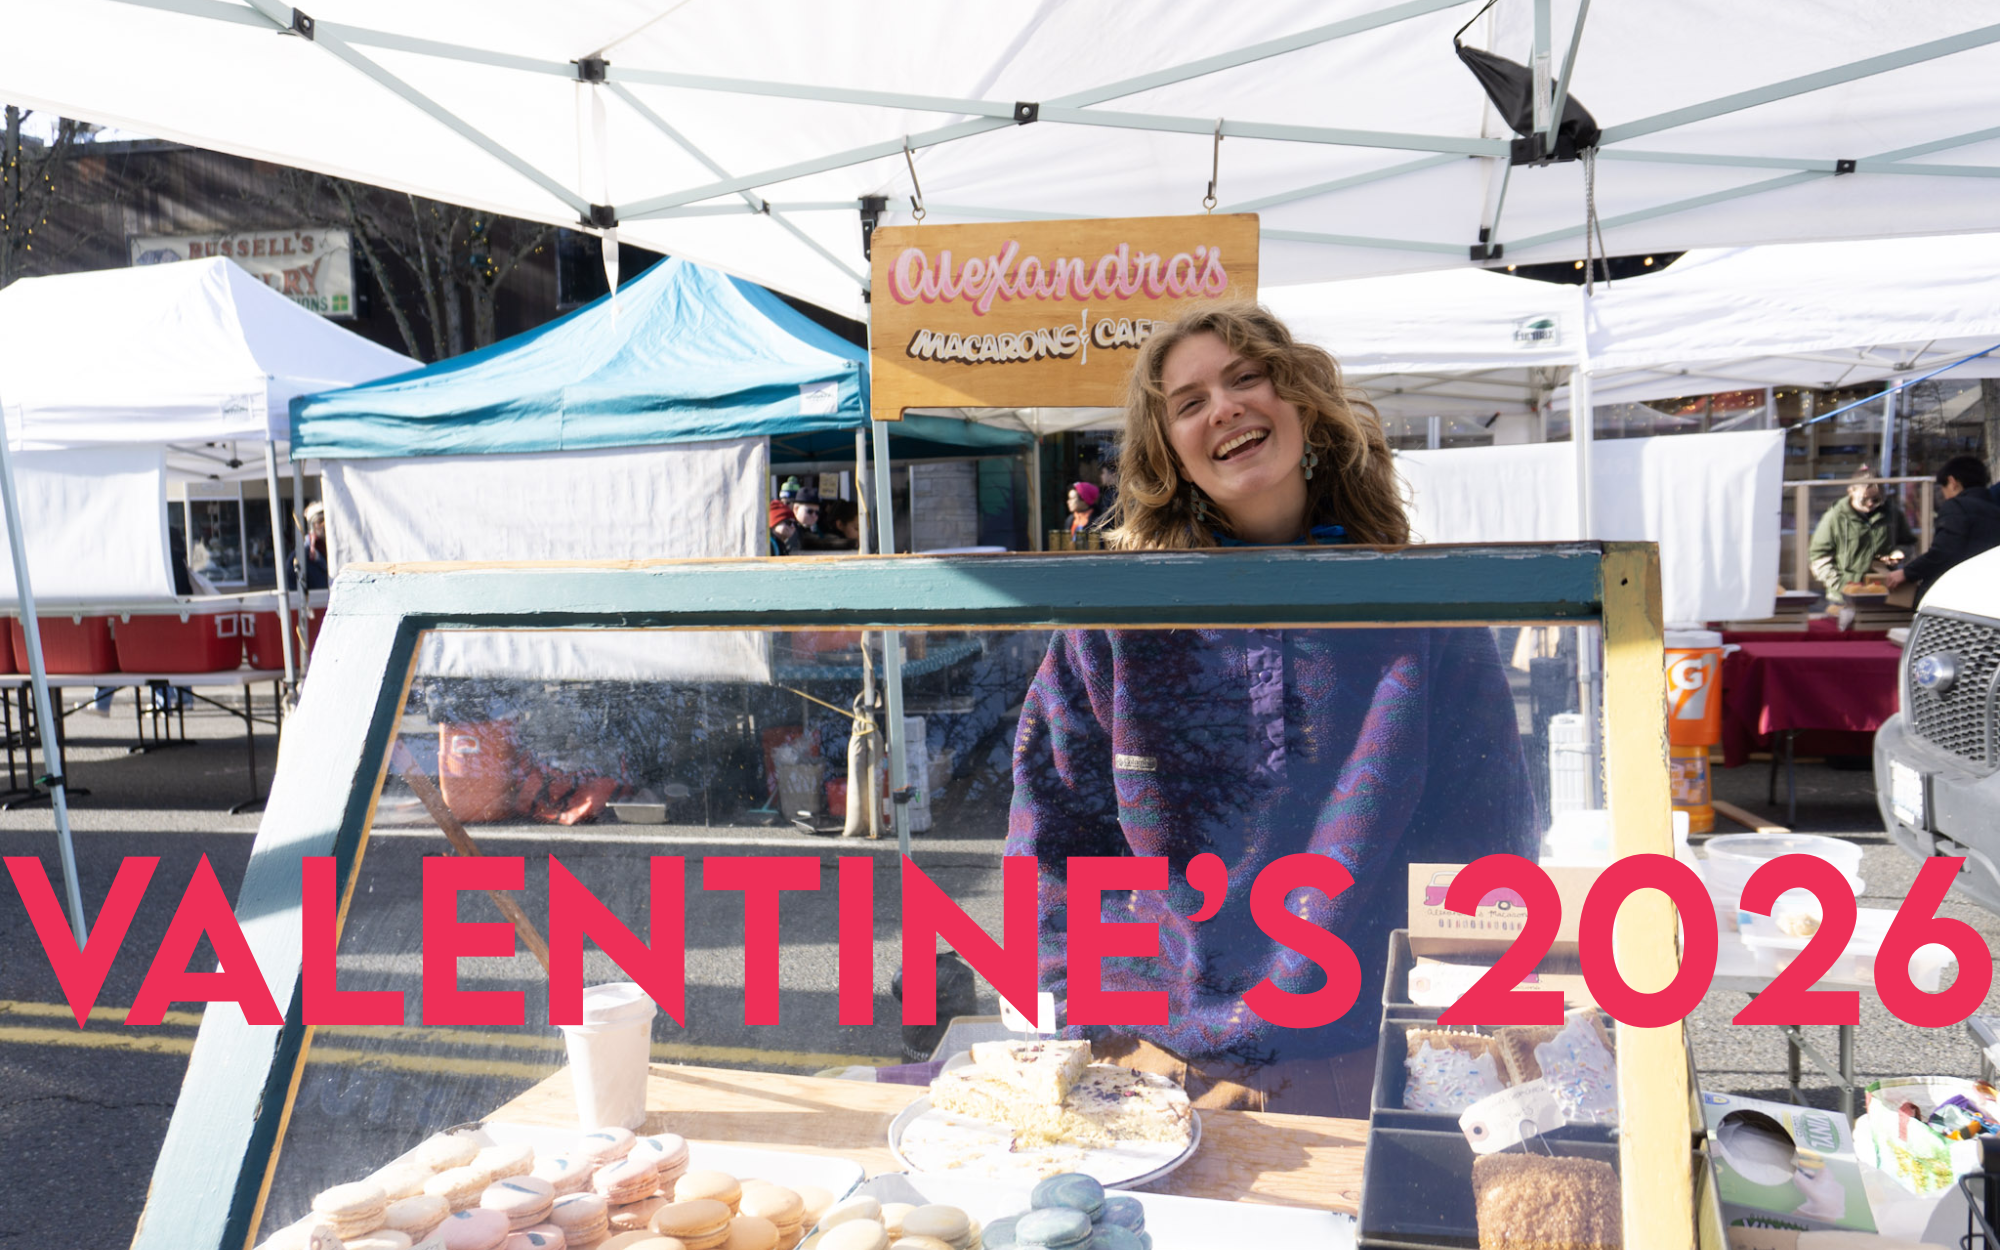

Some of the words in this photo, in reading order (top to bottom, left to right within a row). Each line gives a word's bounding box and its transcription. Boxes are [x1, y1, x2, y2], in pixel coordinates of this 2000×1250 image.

[188, 232, 314, 259] RUSSELL'S
[906, 324, 1078, 365] MACARONS
[1804, 1112, 1837, 1151] VINYL
